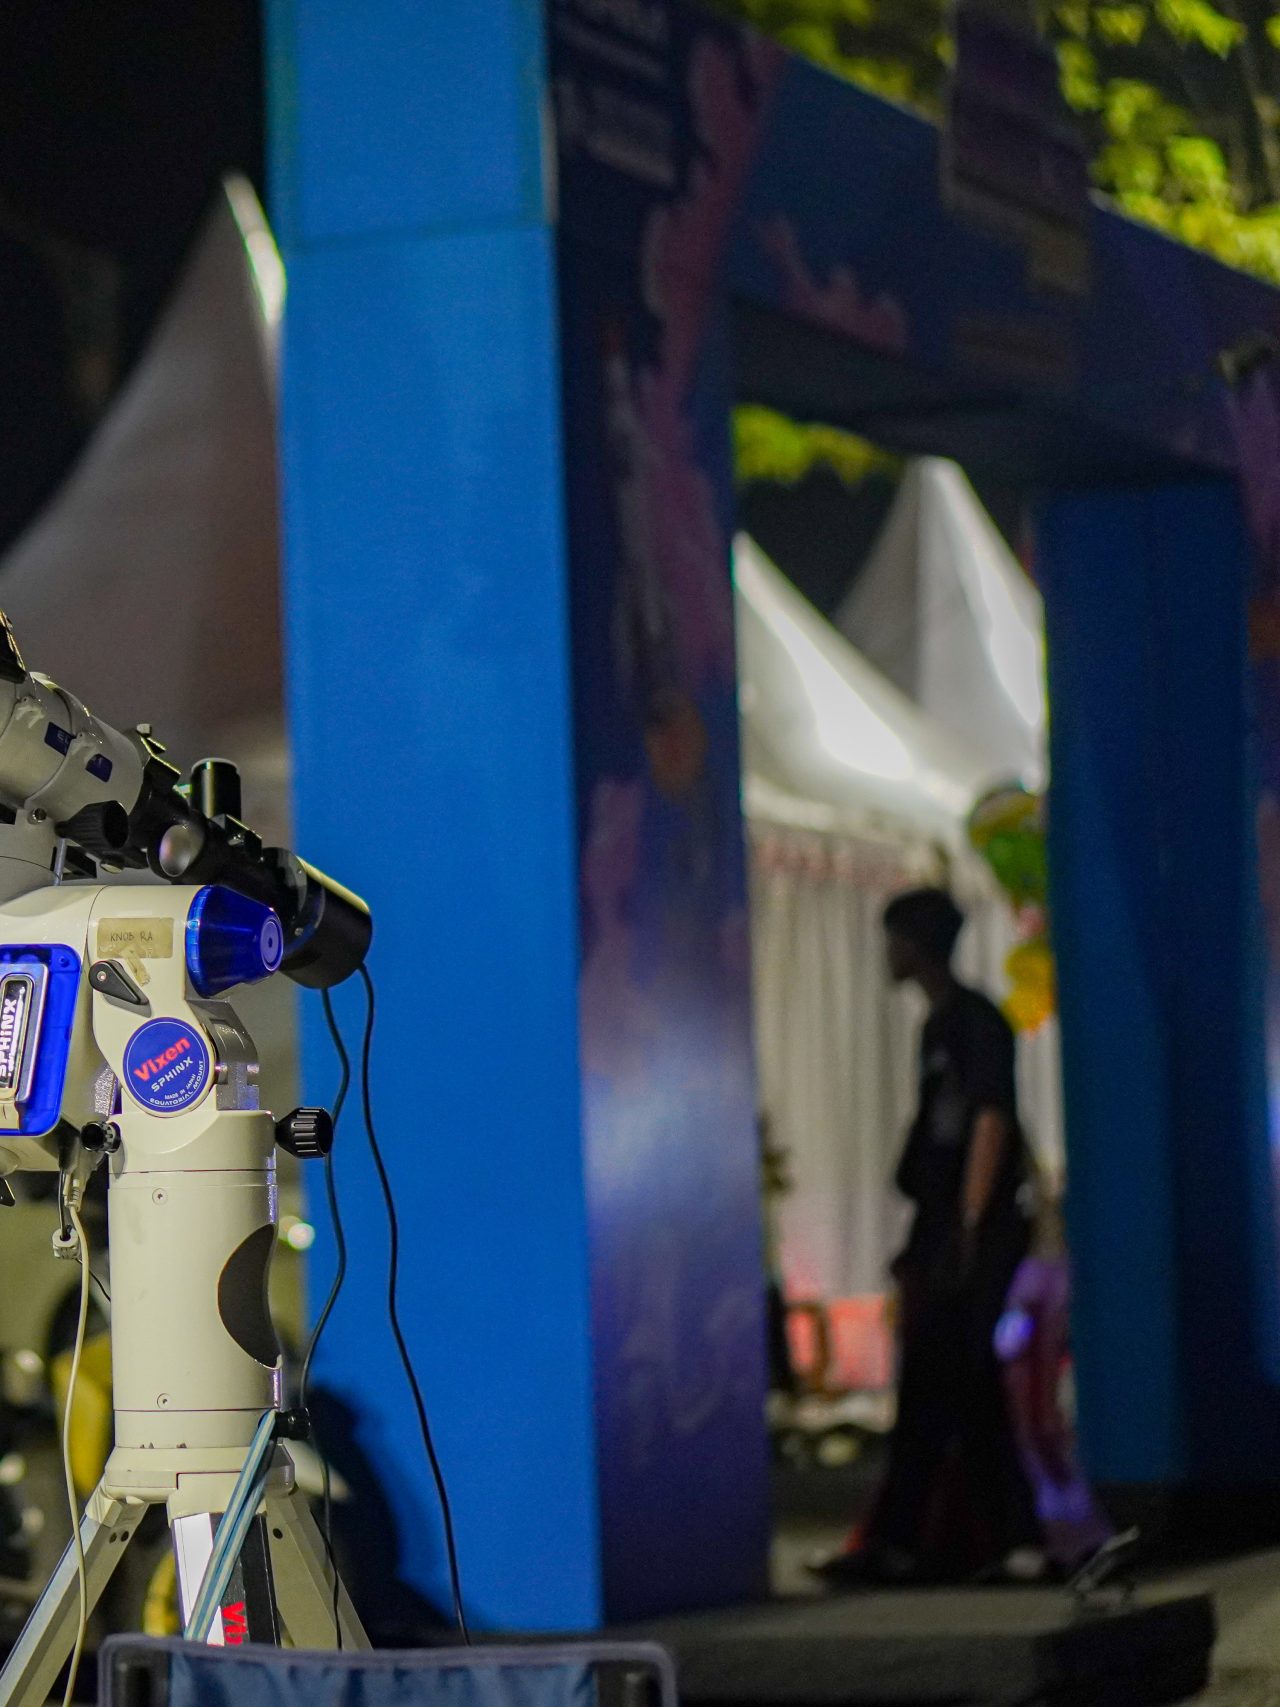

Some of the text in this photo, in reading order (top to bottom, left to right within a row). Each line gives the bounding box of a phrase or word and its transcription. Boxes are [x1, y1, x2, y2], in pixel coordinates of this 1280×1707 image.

[110, 930, 153, 943] KNOB RA
[133, 1037, 191, 1082] Vixen
[151, 1056, 194, 1093] SPHINX
[149, 1060, 205, 1105] EQUATORIAL MOUNT
